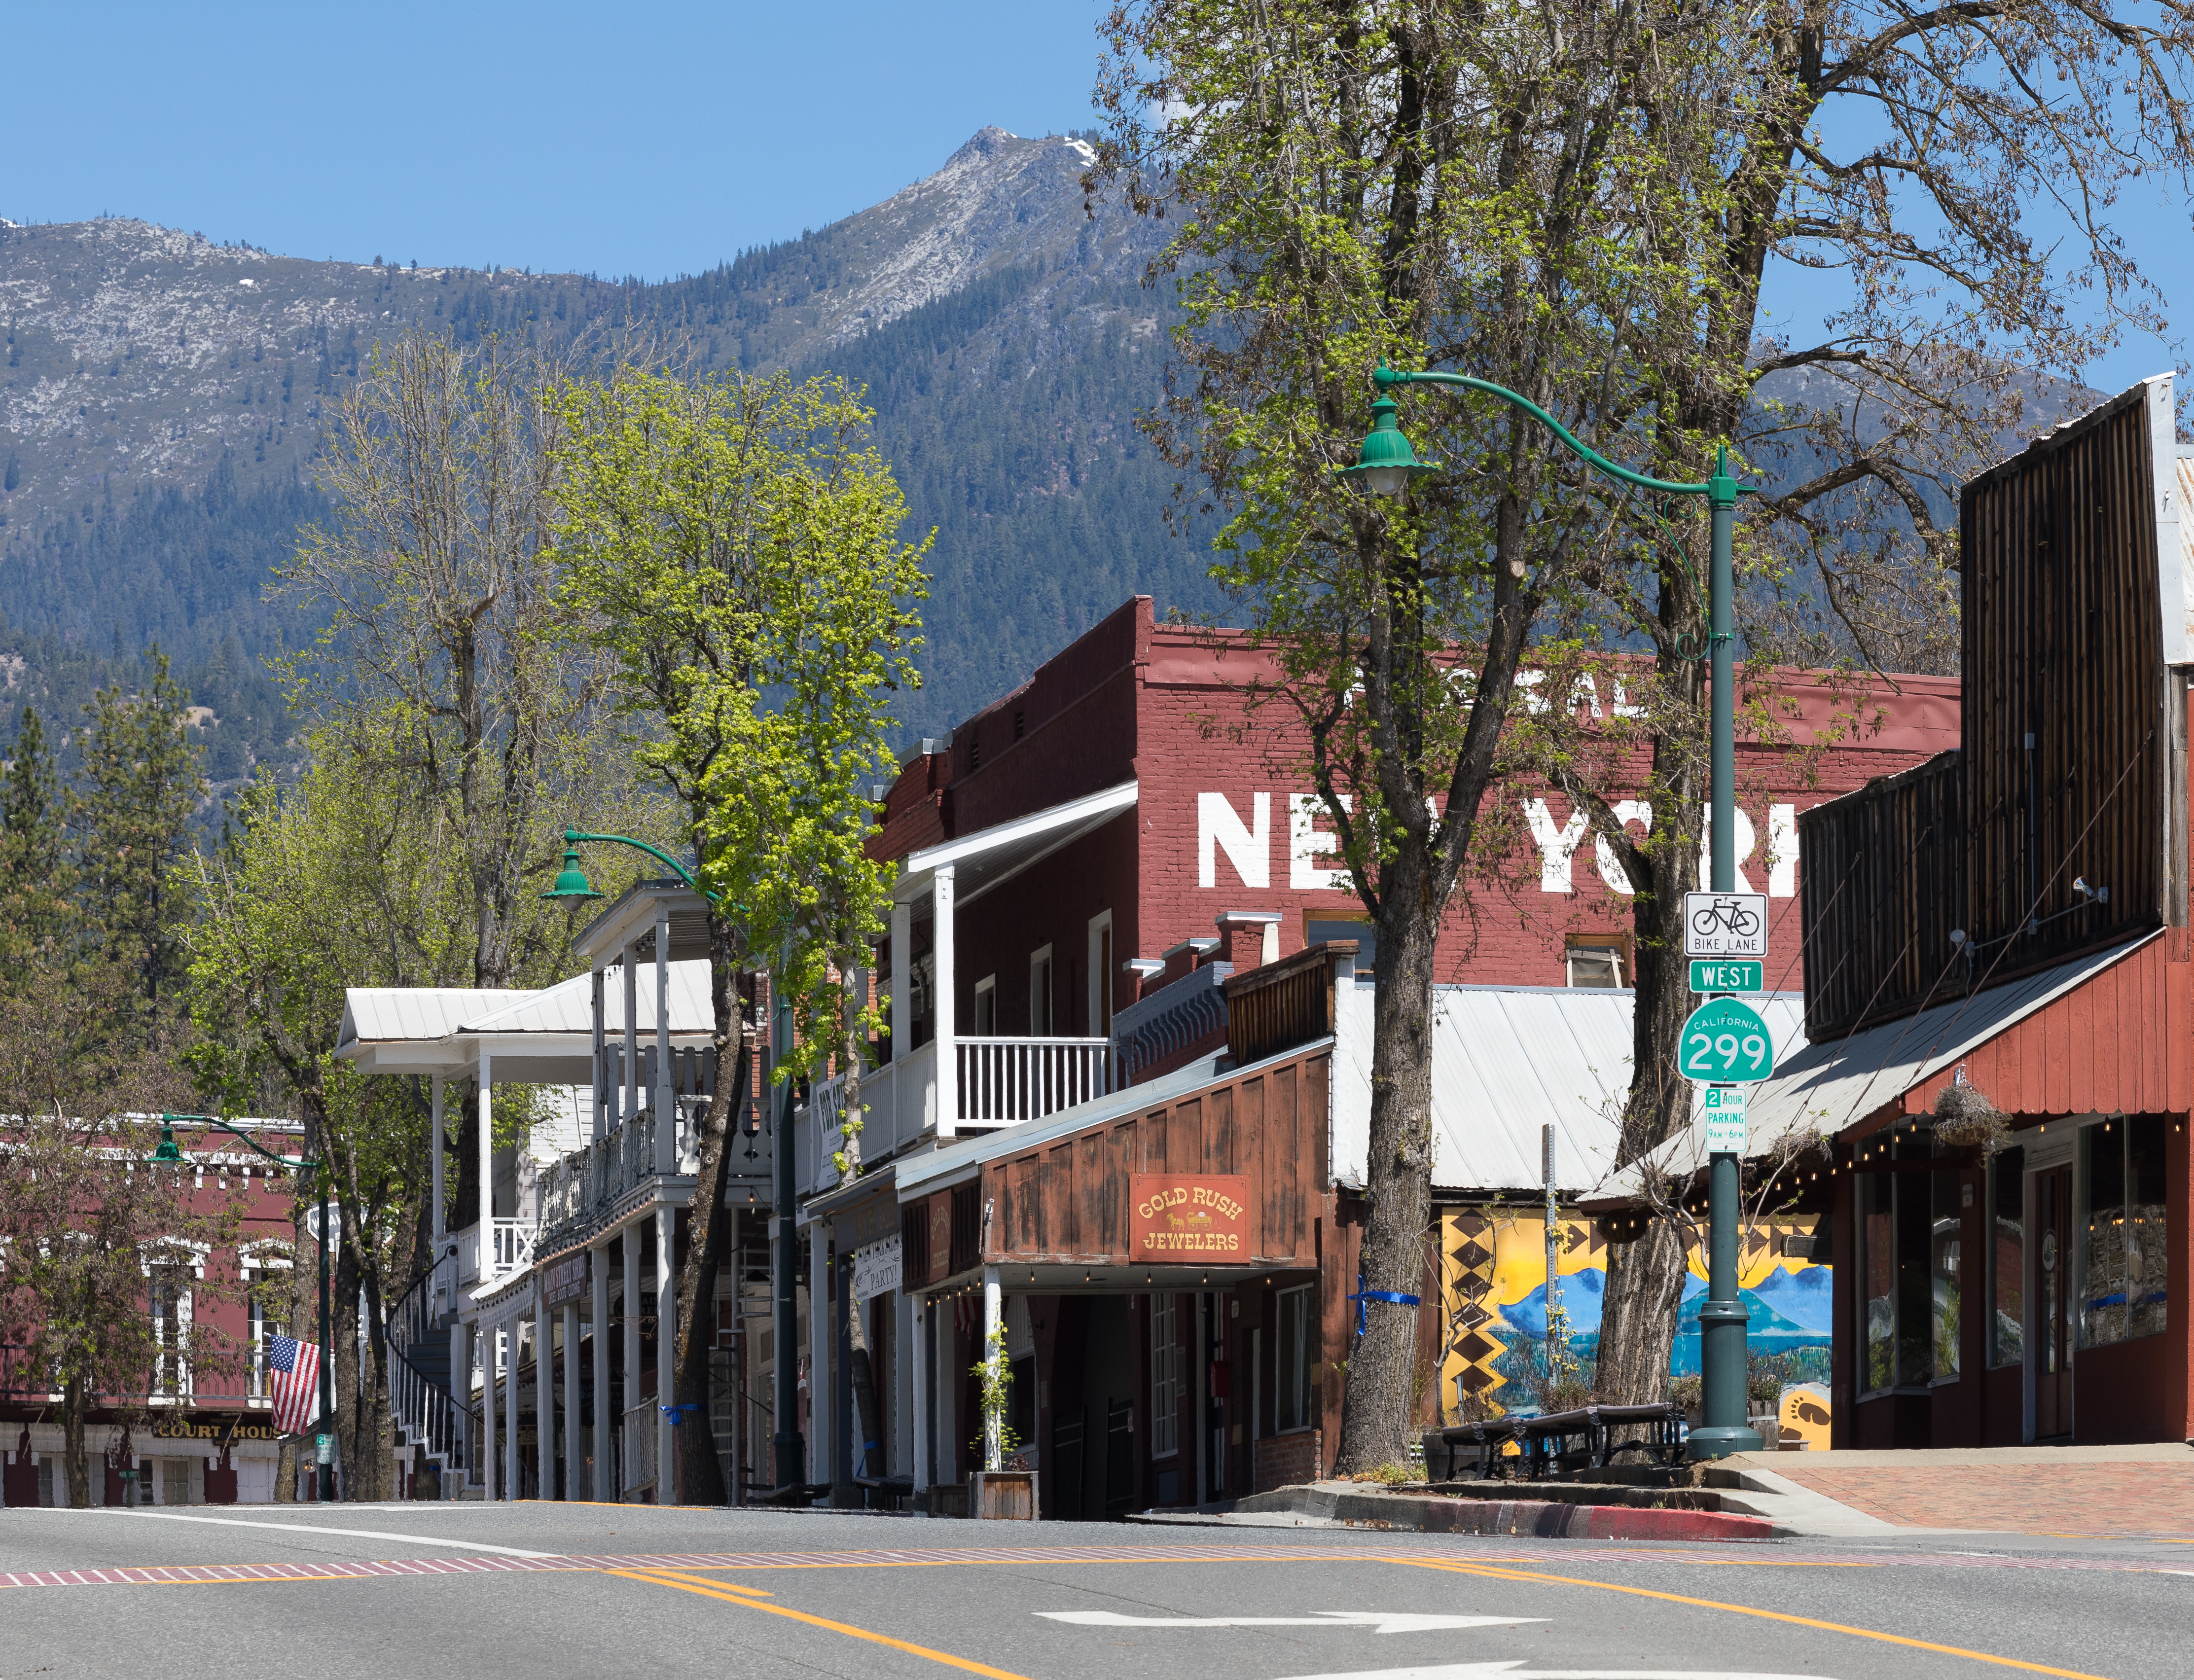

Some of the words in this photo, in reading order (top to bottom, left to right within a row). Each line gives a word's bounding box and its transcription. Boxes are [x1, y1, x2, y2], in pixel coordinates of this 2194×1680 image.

[1198, 791, 1456, 892] NE
[1695, 938, 1720, 950] BIKE
[1728, 939, 1757, 950] LANE
[1702, 967, 1751, 986] WEST
[1694, 1017, 1759, 1032] CALIFORNIA
[1688, 1033, 1765, 1071] 299
[1709, 1091, 1718, 1105] 2
[1723, 1095, 1742, 1105] HOUR
[819, 1089, 833, 1134] FOR
[1708, 1112, 1744, 1124] PARKING
[1139, 1187, 1187, 1219] GOLD
[1192, 1186, 1243, 1221] RUSH
[1143, 1232, 1239, 1251] JEWELERS
[556, 1261, 572, 1288] STREET
[870, 1264, 897, 1291] PARTY!
[159, 1425, 221, 1437] COURT
